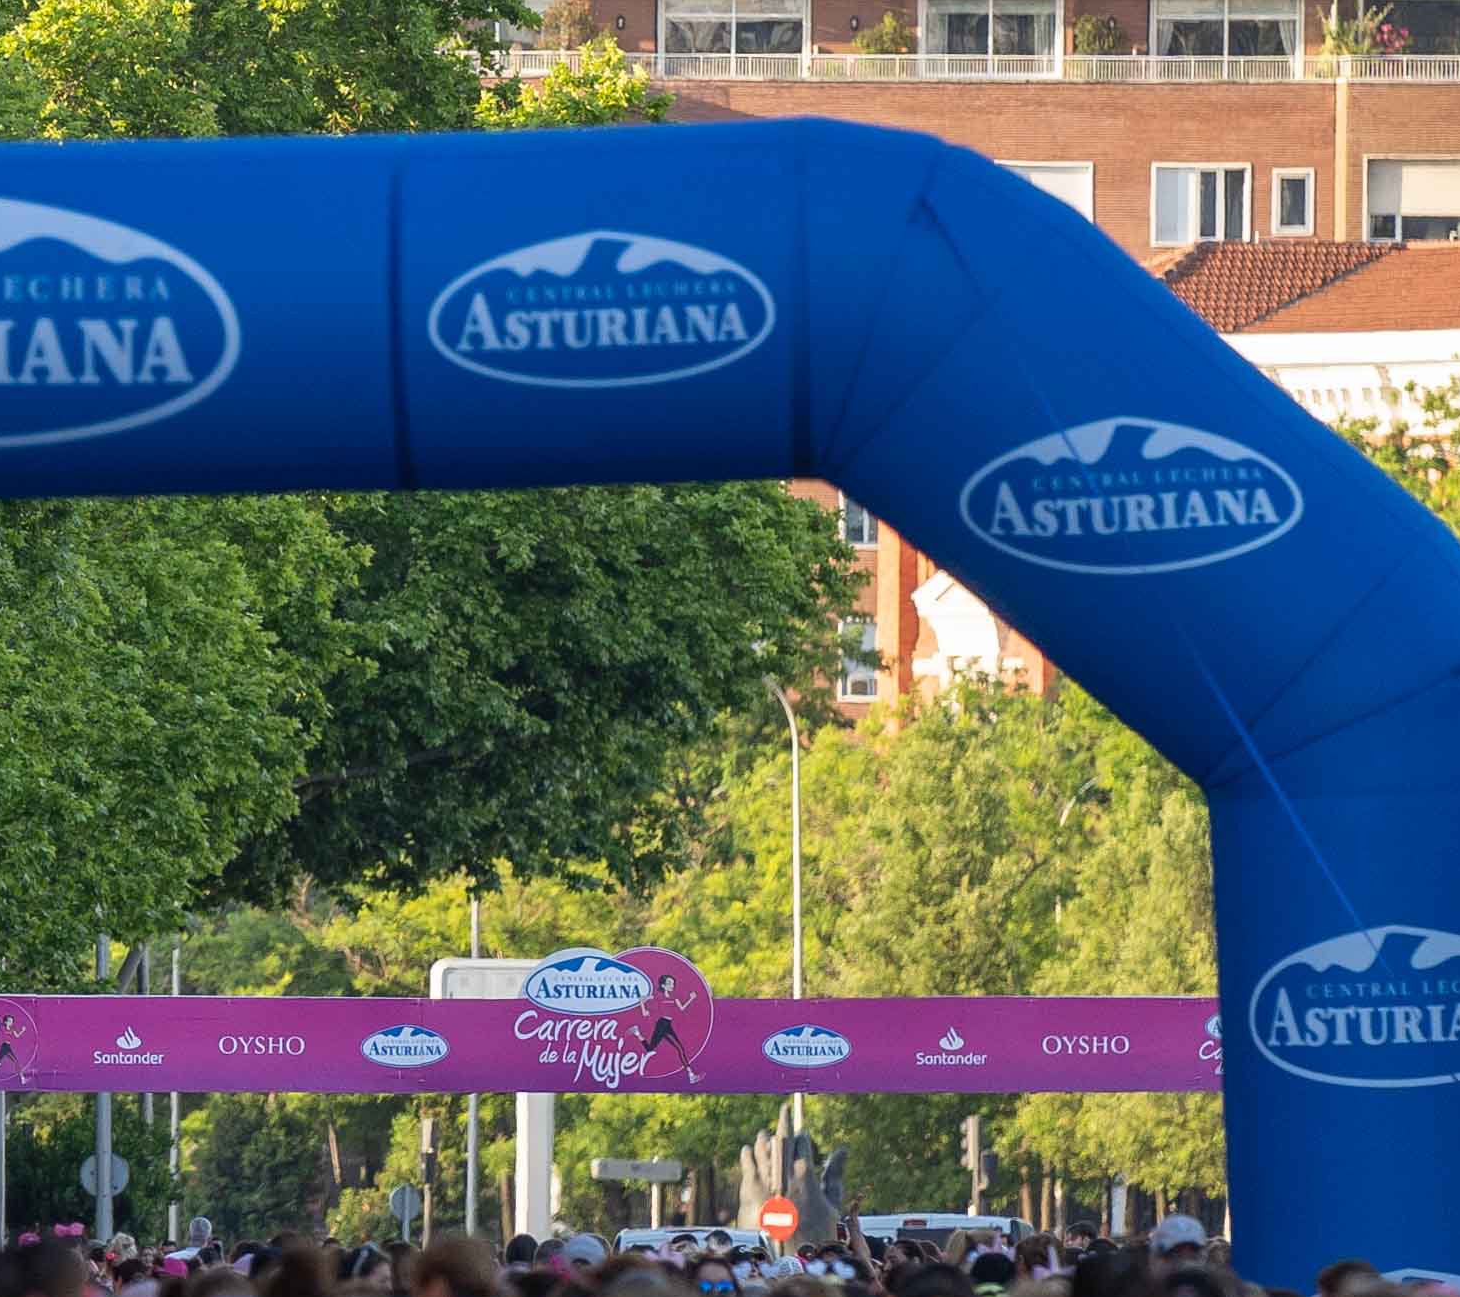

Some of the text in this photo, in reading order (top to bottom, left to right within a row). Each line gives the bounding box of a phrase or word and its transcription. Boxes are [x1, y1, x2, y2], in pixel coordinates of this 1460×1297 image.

[455, 291, 748, 352] ASTURIANA
[989, 480, 1281, 537] ASTURIANA
[535, 976, 642, 999] ASTURIANA
[1306, 982, 1411, 999] CENTRAL
[514, 1010, 618, 1042] Carrera
[218, 1036, 306, 1055] OYSHO
[369, 1040, 442, 1056] ASTURIANA
[770, 1040, 844, 1057] ASTURIANA
[1042, 1034, 1130, 1055] OYSHO
[94, 1051, 165, 1065] Santander
[538, 1038, 657, 1089] de la Mujer
[916, 1050, 988, 1066] Santander
